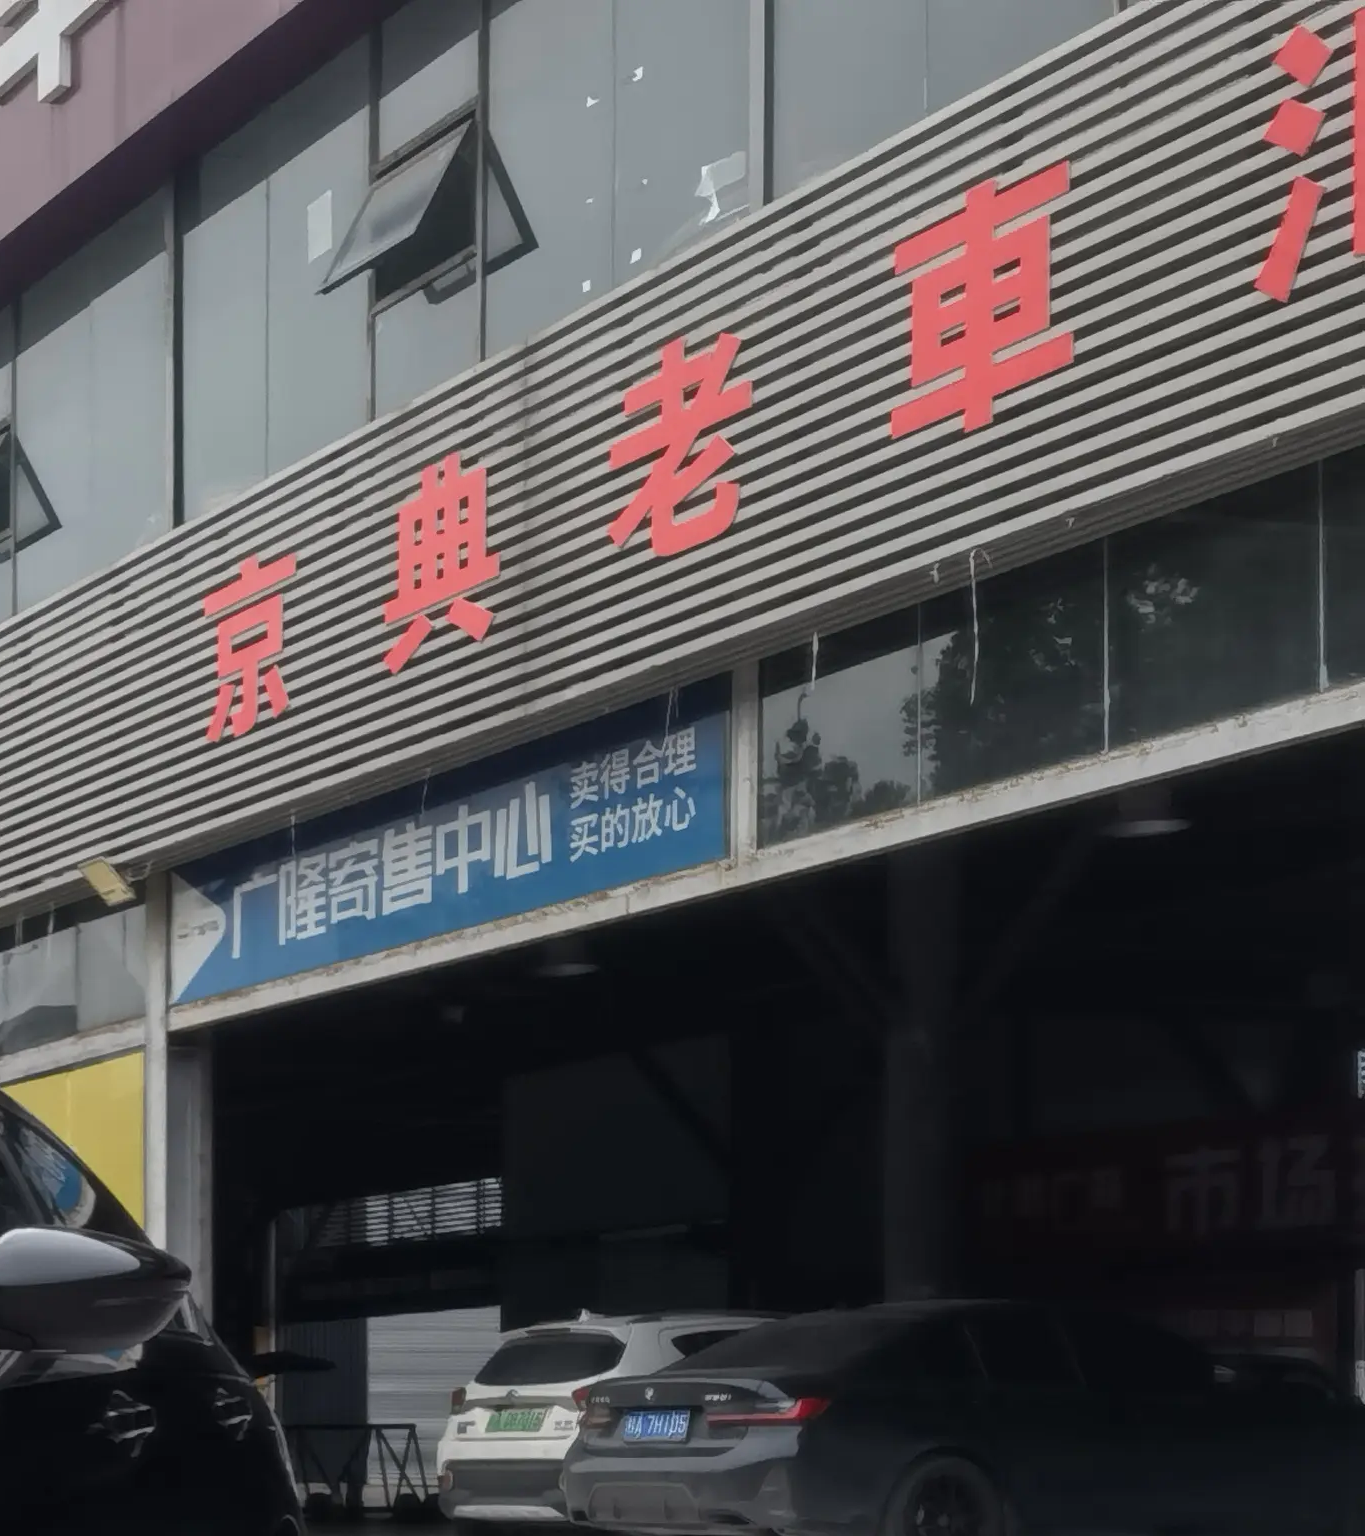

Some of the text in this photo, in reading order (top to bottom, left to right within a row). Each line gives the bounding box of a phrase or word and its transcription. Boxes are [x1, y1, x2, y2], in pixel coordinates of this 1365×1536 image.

[570, 727, 697, 810] 卖得合理
[570, 786, 697, 863] 买的放心
[231, 781, 553, 960] 广隆寄售中心
